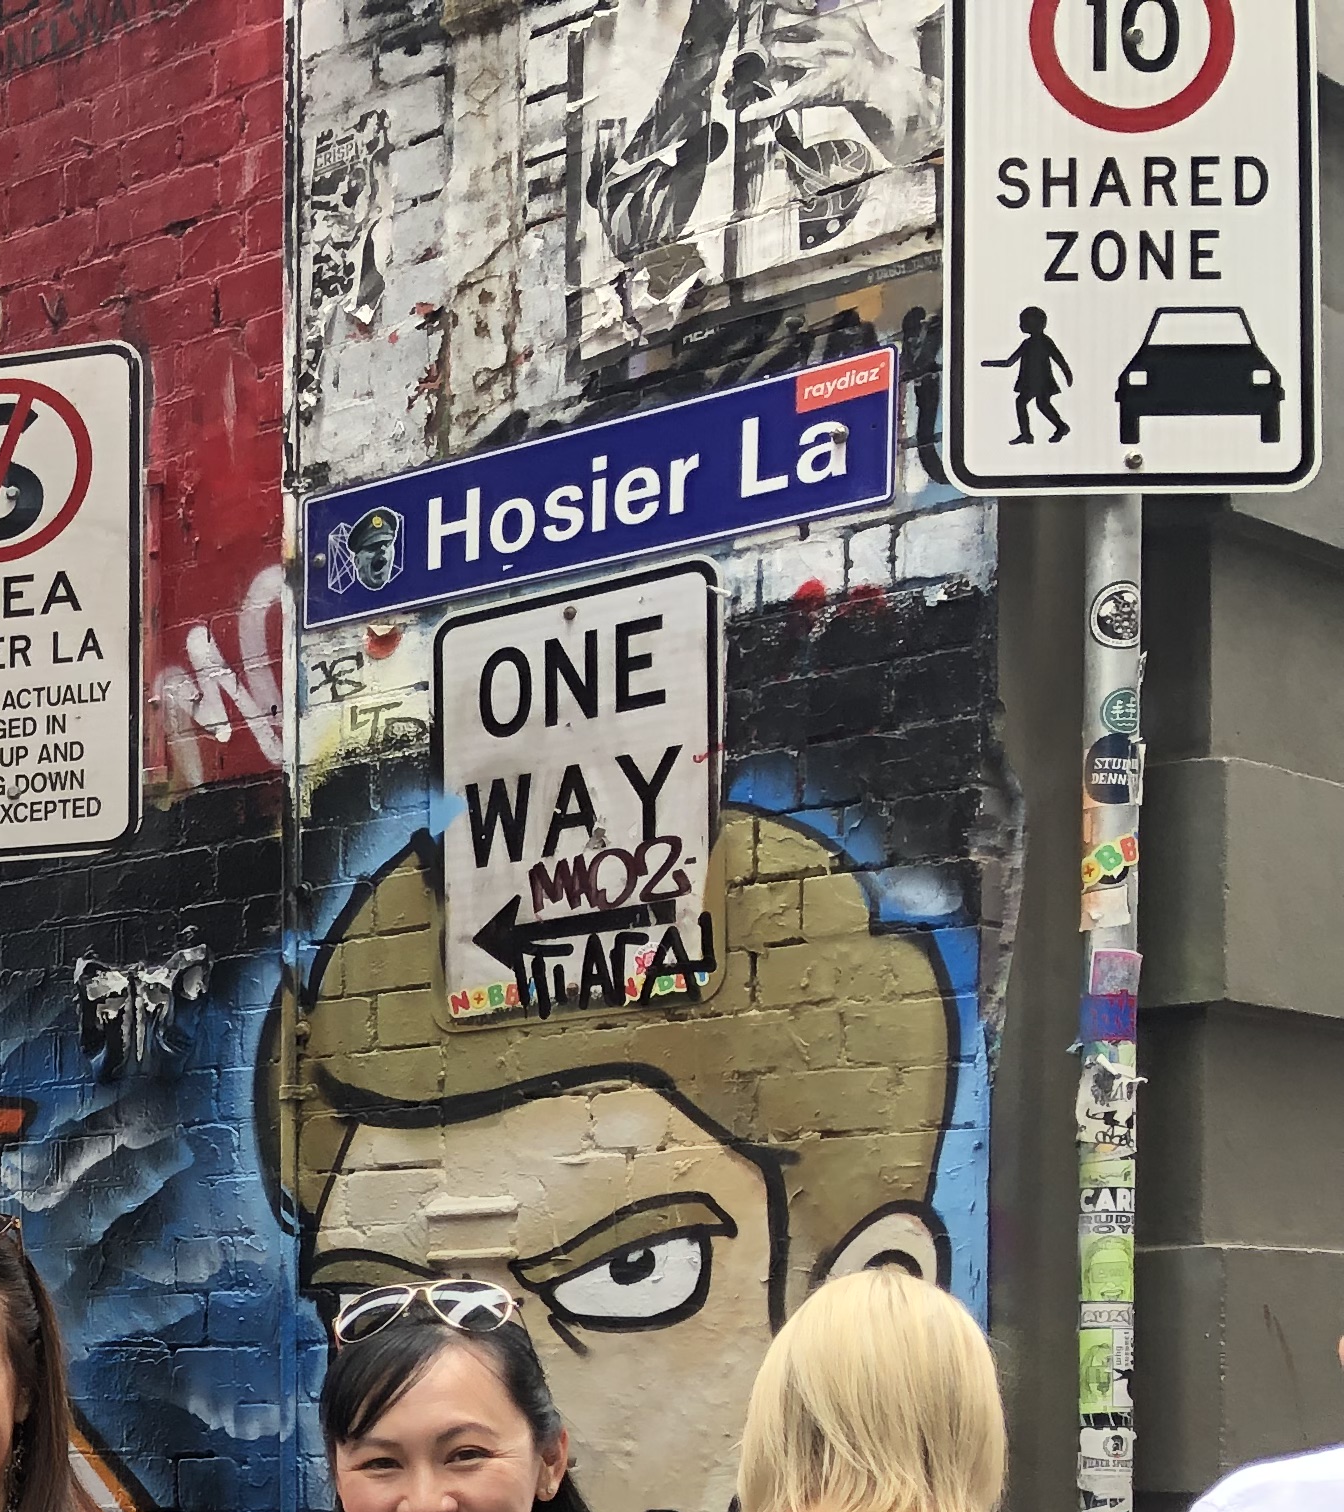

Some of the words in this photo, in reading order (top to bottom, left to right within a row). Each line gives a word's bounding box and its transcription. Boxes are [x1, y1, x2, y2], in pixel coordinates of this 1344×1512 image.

[1086, 0, 1181, 74] 10
[996, 156, 1270, 209] SHARED
[1043, 229, 1223, 282] ZONE
[426, 451, 700, 571] Hosier
[739, 416, 847, 498] La
[52, 628, 104, 665] LA
[2, 680, 112, 711] ACTUALLY
[479, 613, 667, 738] ONE
[46, 713, 67, 735] IN
[0, 745, 29, 768] UP
[37, 740, 85, 764] AND
[14, 768, 85, 796] DOWN
[465, 743, 684, 868] WAY
